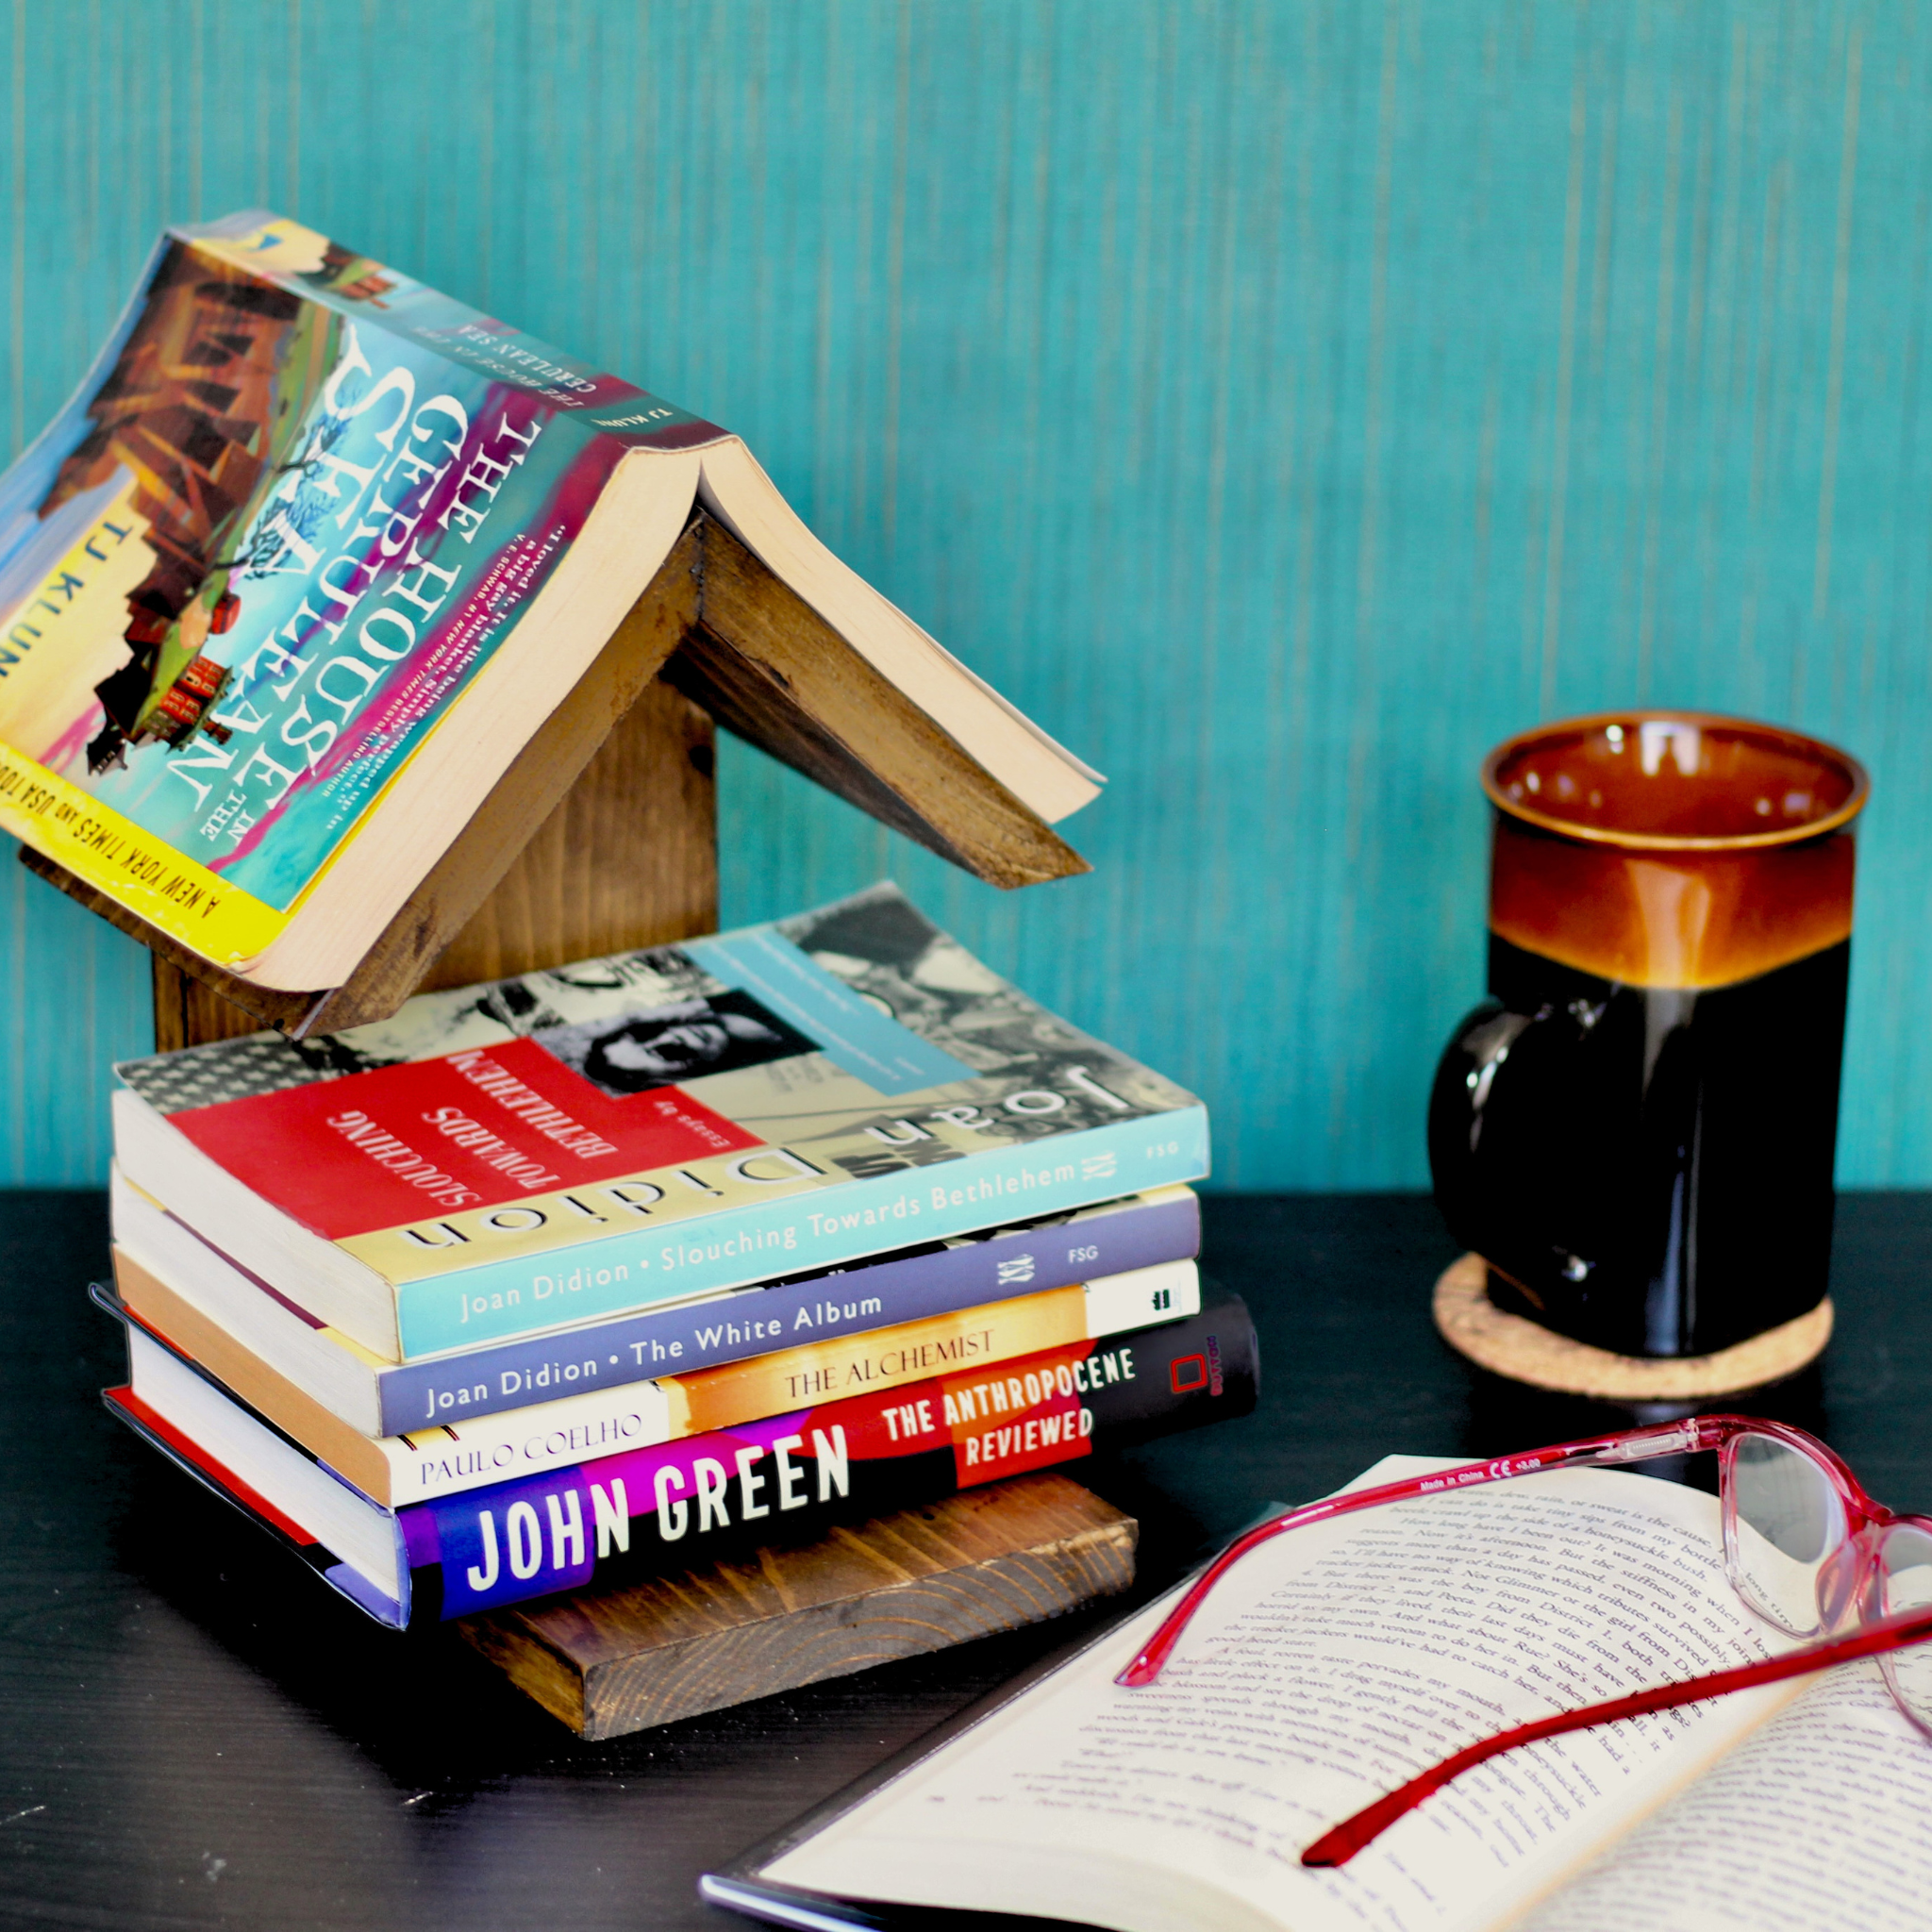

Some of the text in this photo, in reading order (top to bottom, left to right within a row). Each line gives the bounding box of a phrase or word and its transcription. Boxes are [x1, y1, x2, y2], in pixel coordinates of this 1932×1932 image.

[459, 325, 597, 393] CERULEAN SEA
[538, 388, 585, 408] THE
[648, 408, 673, 421] TJ
[234, 324, 415, 575] SEA
[85, 522, 134, 561] TJ
[504, 554, 531, 581] big
[517, 543, 554, 589] loved
[525, 540, 537, 551] a
[167, 394, 468, 812] CERULEAN
[233, 412, 541, 809] THE HOUSE
[485, 582, 508, 612] gay
[492, 609, 508, 626] It
[504, 590, 522, 608] it.
[435, 613, 490, 675] blanket.
[454, 645, 482, 674] like
[478, 627, 496, 643] is
[322, 533, 525, 797] V. E. SCHWAB, #1 NEW YORK TIMES BESTSELLING AUTHOR
[389, 678, 437, 733] Simply
[415, 675, 457, 718] being
[359, 721, 418, 789] wrapped
[20, 782, 56, 816] USA
[55, 803, 79, 824] AND
[199, 789, 247, 841] THE
[227, 810, 257, 842] IN
[326, 814, 343, 830] in
[341, 791, 360, 811] up
[73, 818, 126, 859] TIMES
[120, 847, 169, 887] YORK
[161, 874, 207, 910] NEW
[201, 897, 222, 919] A
[446, 1049, 619, 1158] BETHLEHEM
[654, 1100, 732, 1148] Essays by
[326, 1109, 483, 1208] SLOUCHING
[397, 1065, 1130, 1249] Joan Didion
[421, 1107, 560, 1189] TOWARDS
[460, 1140, 1180, 1324] Joan Didion Slouching Towards Bethlehem FSG
[425, 1244, 1099, 1418] Joan Didion The White Album FSG
[421, 1328, 996, 1486] PAULO COELHO THE ALCHEMIST
[965, 1407, 1093, 1467] REVIEWED
[467, 1348, 1137, 1591] JOHN GREEN THE ANTHROPOCENE
[1420, 1479, 1444, 1491] Made
[1446, 1475, 1456, 1485] in
[1457, 1471, 1484, 1483] China
[1546, 1508, 1722, 1570] tiny sips from my bottle
[1584, 1526, 1669, 1560] honeysuckle
[1672, 1557, 1707, 1582] bush.
[1589, 1504, 1628, 1515] sweat
[1631, 1511, 1643, 1520] is
[1646, 1517, 1671, 1528] the
[1673, 1527, 1711, 1548] cause.
[1479, 1537, 1725, 1633] afternoon. But the stiffness in my
[1497, 1550, 1524, 1560] day
[1527, 1555, 1552, 1566] has
[1612, 1583, 1645, 1601] even
[1650, 1601, 1676, 1620] two
[1521, 1528, 1554, 1540] been
[1558, 1537, 1591, 1547] out?
[1593, 1543, 1607, 1553] It
[1612, 1551, 1639, 1563] was
[1641, 1562, 1703, 1598] morning
[1707, 1597, 1740, 1626] when
[1743, 1627, 1754, 1636] I
[1461, 1570, 1671, 1658] Not Glimmer or the girl from
[1461, 1582, 1490, 1593] boy
[1495, 1591, 1531, 1605] from
[1538, 1602, 1594, 1629] District
[1621, 1640, 1654, 1668] both
[1484, 1560, 1709, 1667] knowing which tributes survived
[1427, 1618, 1462, 1630] what
[1466, 1627, 1508, 1644] about
[1513, 1641, 1551, 1660] Rue?
[1591, 1685, 1607, 1697] so
[1441, 1607, 1625, 1689] their last days must have
[1471, 1661, 1509, 1679] catch
[1485, 1601, 1648, 1684] Did they die from the
[1473, 1643, 1499, 1657] her
[1525, 1663, 1554, 1683] But
[1556, 1681, 1587, 1705] then
